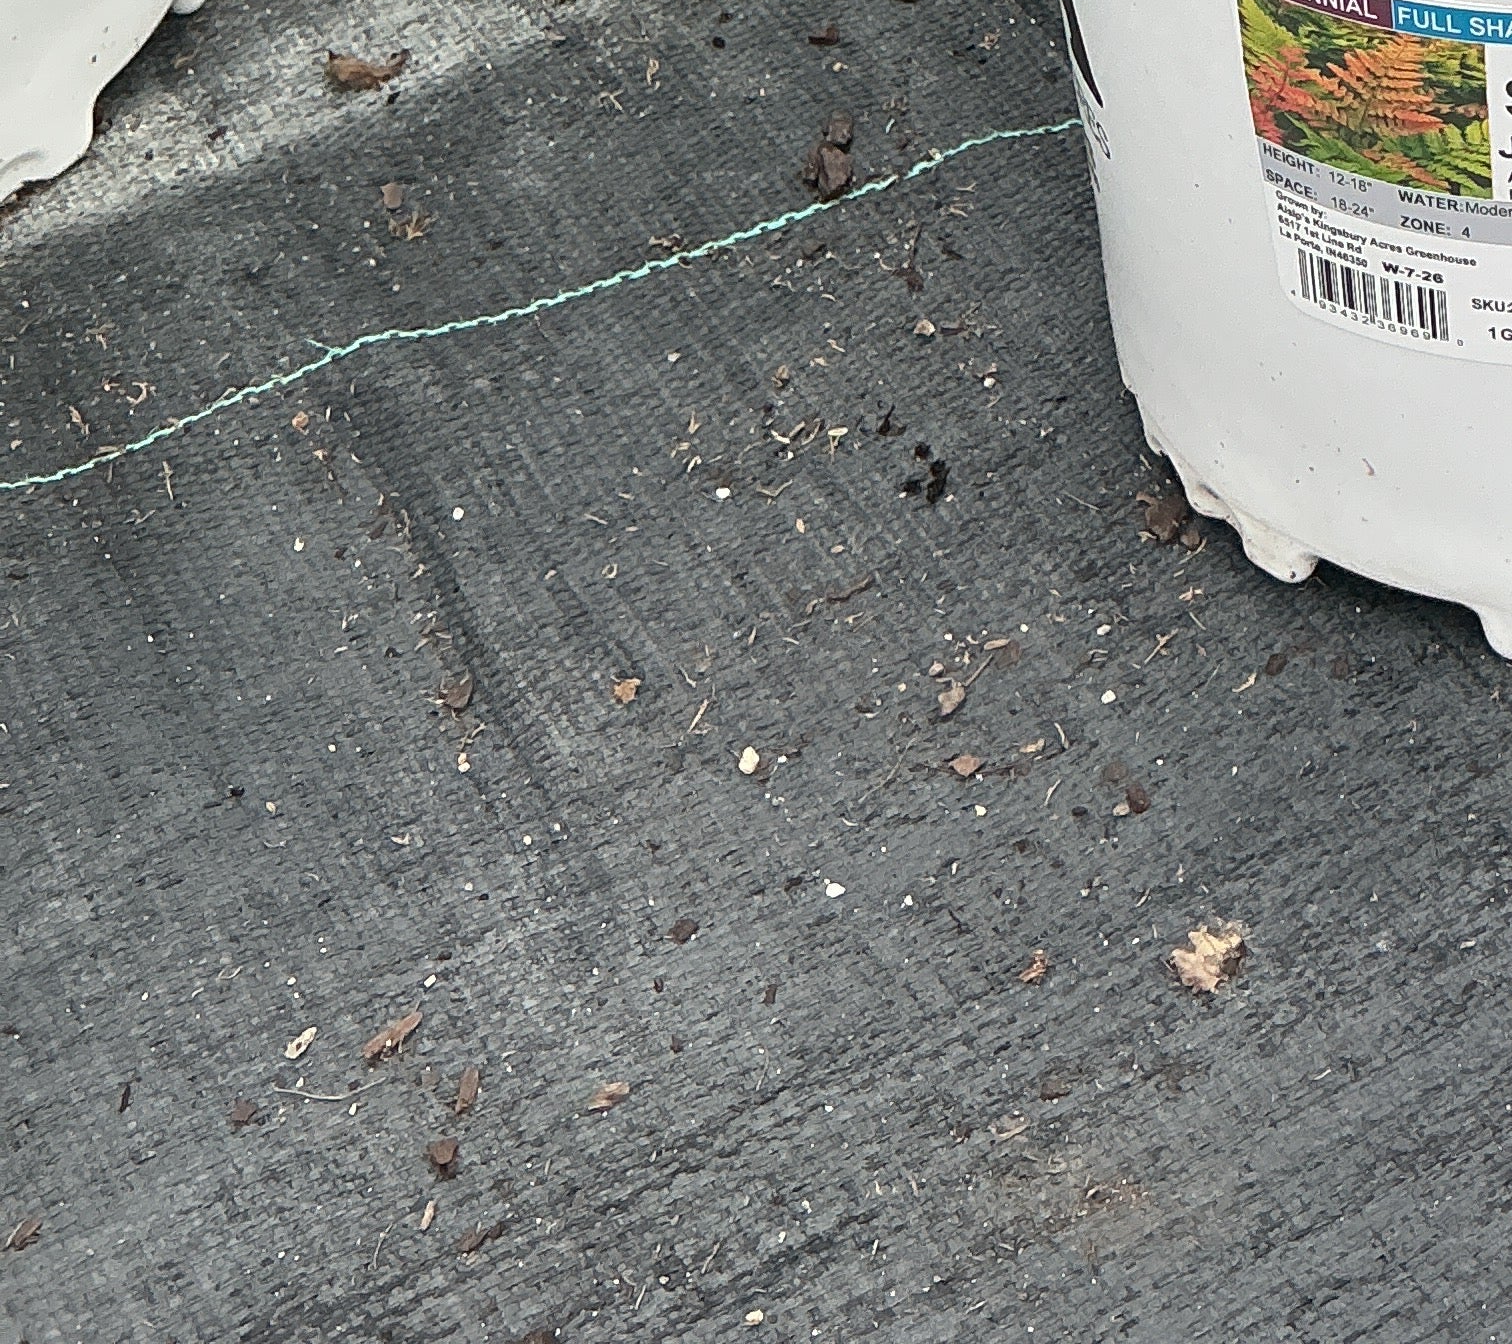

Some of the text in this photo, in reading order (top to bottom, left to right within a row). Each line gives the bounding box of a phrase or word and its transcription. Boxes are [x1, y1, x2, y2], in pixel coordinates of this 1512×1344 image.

[1397, 6, 1461, 34] FULL
[1262, 143, 1374, 193] HEIGHT: 12-18"
[1265, 168, 1376, 218] SPACE: 18-24"
[1275, 190, 1328, 220] Grown by:
[1397, 189, 1464, 213] WATER:
[1278, 214, 1301, 231] 6517
[1346, 242, 1363, 255] Rd
[1279, 226, 1292, 240] La
[1400, 215, 1472, 239] ZONE: 4
[1312, 218, 1368, 245] Kingsbury
[1369, 237, 1402, 254] Acres
[1405, 246, 1477, 267] Greenhouse
[1382, 261, 1445, 284] W-7-26
[1487, 326, 1496, 340] 1
